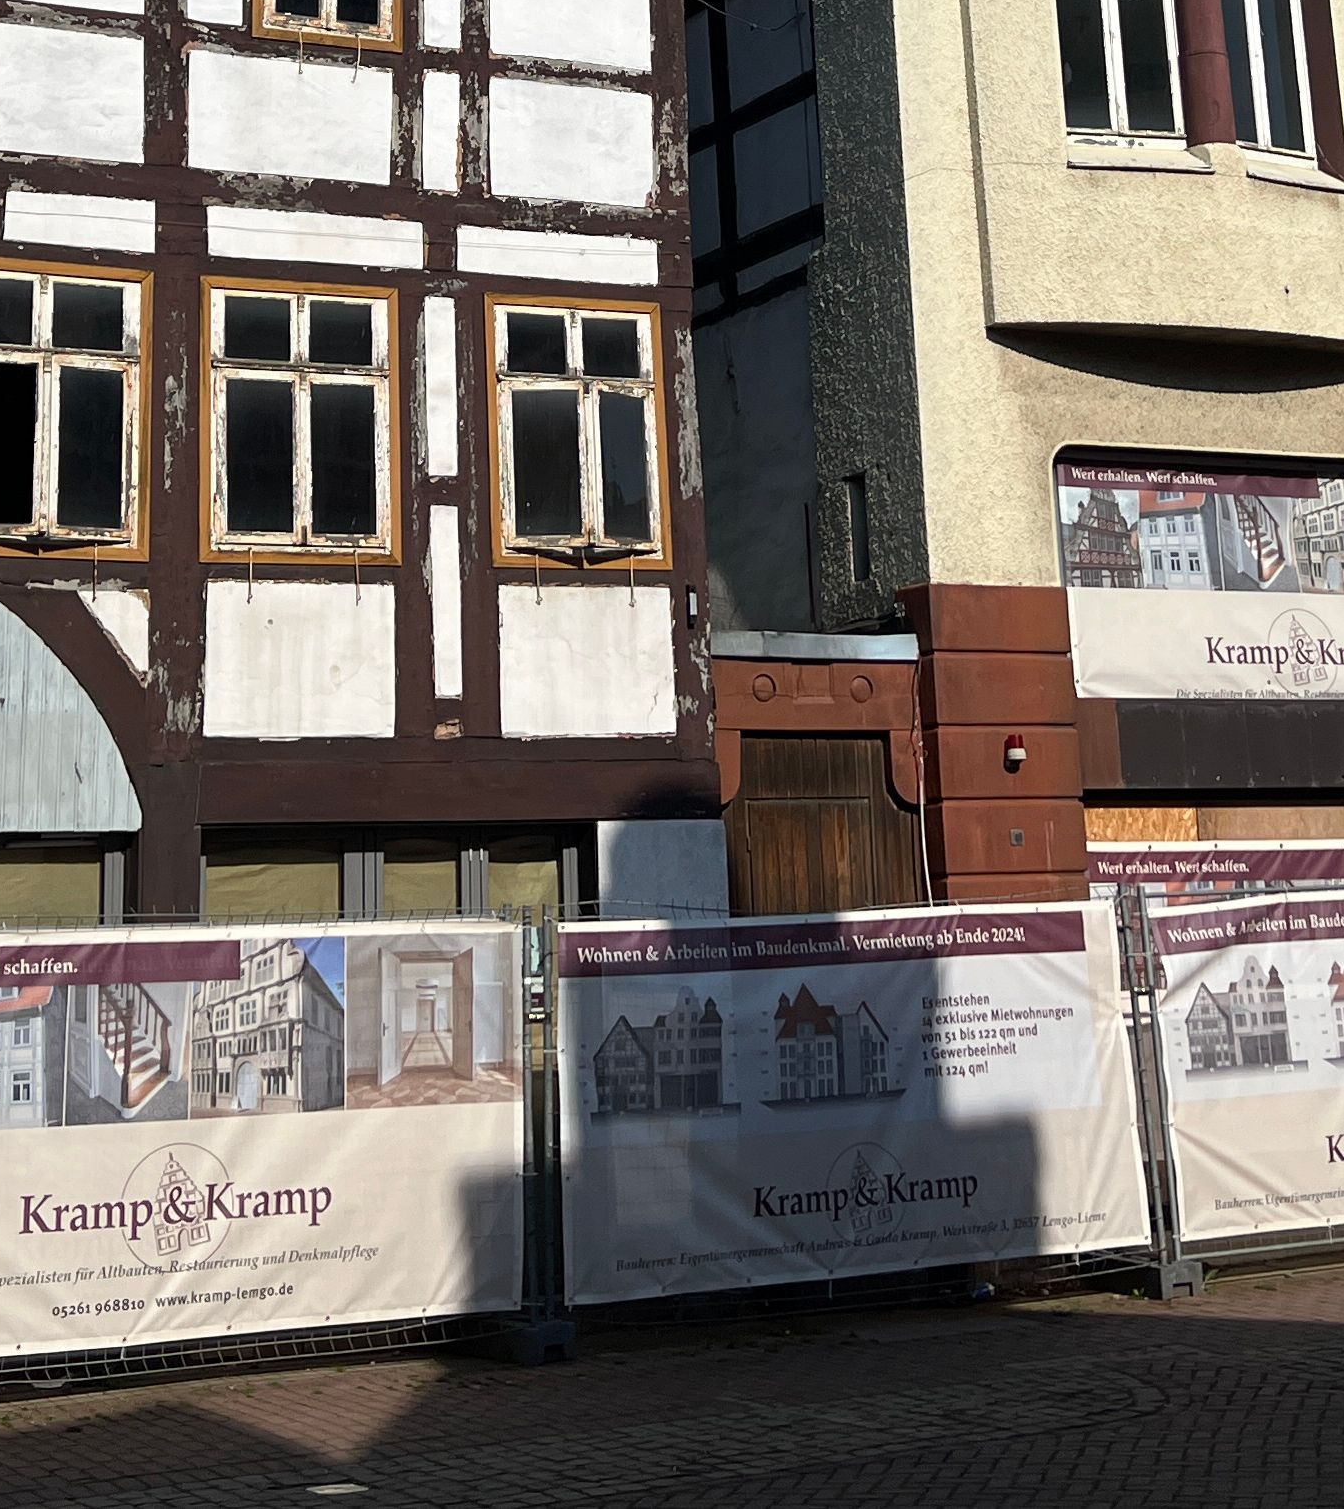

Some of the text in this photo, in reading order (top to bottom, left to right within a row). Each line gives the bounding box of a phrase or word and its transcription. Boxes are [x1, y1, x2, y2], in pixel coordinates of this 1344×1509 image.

[1071, 467, 1217, 486] Wert erhalten. Wert schaffen.
[1204, 636, 1289, 674] Kramp
[1295, 639, 1315, 665] &
[1097, 859, 1250, 874] Wert erhalten. Wert schaffen.
[1167, 925, 1224, 943] Wohnen
[1226, 922, 1237, 936] &
[1289, 914, 1307, 929] im
[577, 927, 1025, 963] Wohnen & Arbeiten im Baudenkmal. Vermietung ab Ende 2024!
[3, 958, 78, 975] schaffen.
[922, 993, 990, 1009] Es entstehen
[922, 1007, 1073, 1028] 14 exklusive Mietwohnungen
[921, 1024, 1038, 1045] von 51 bis 122 qm und
[922, 1042, 1017, 1061] 1 Gewerbeeinheit
[924, 1061, 988, 1078] mit 124 qm!
[753, 1172, 978, 1221] Kramp & Kramp
[19, 1182, 332, 1240] Kramp & Kramp
[73, 1267, 94, 1285] für
[96, 1263, 165, 1280] Altbauten,
[169, 1255, 259, 1273] Restaurierung
[262, 1251, 286, 1266] und
[288, 1245, 380, 1264] Denkmalpflege
[52, 1282, 294, 1318] 05261 968810 www.kramp-lemgo.de
